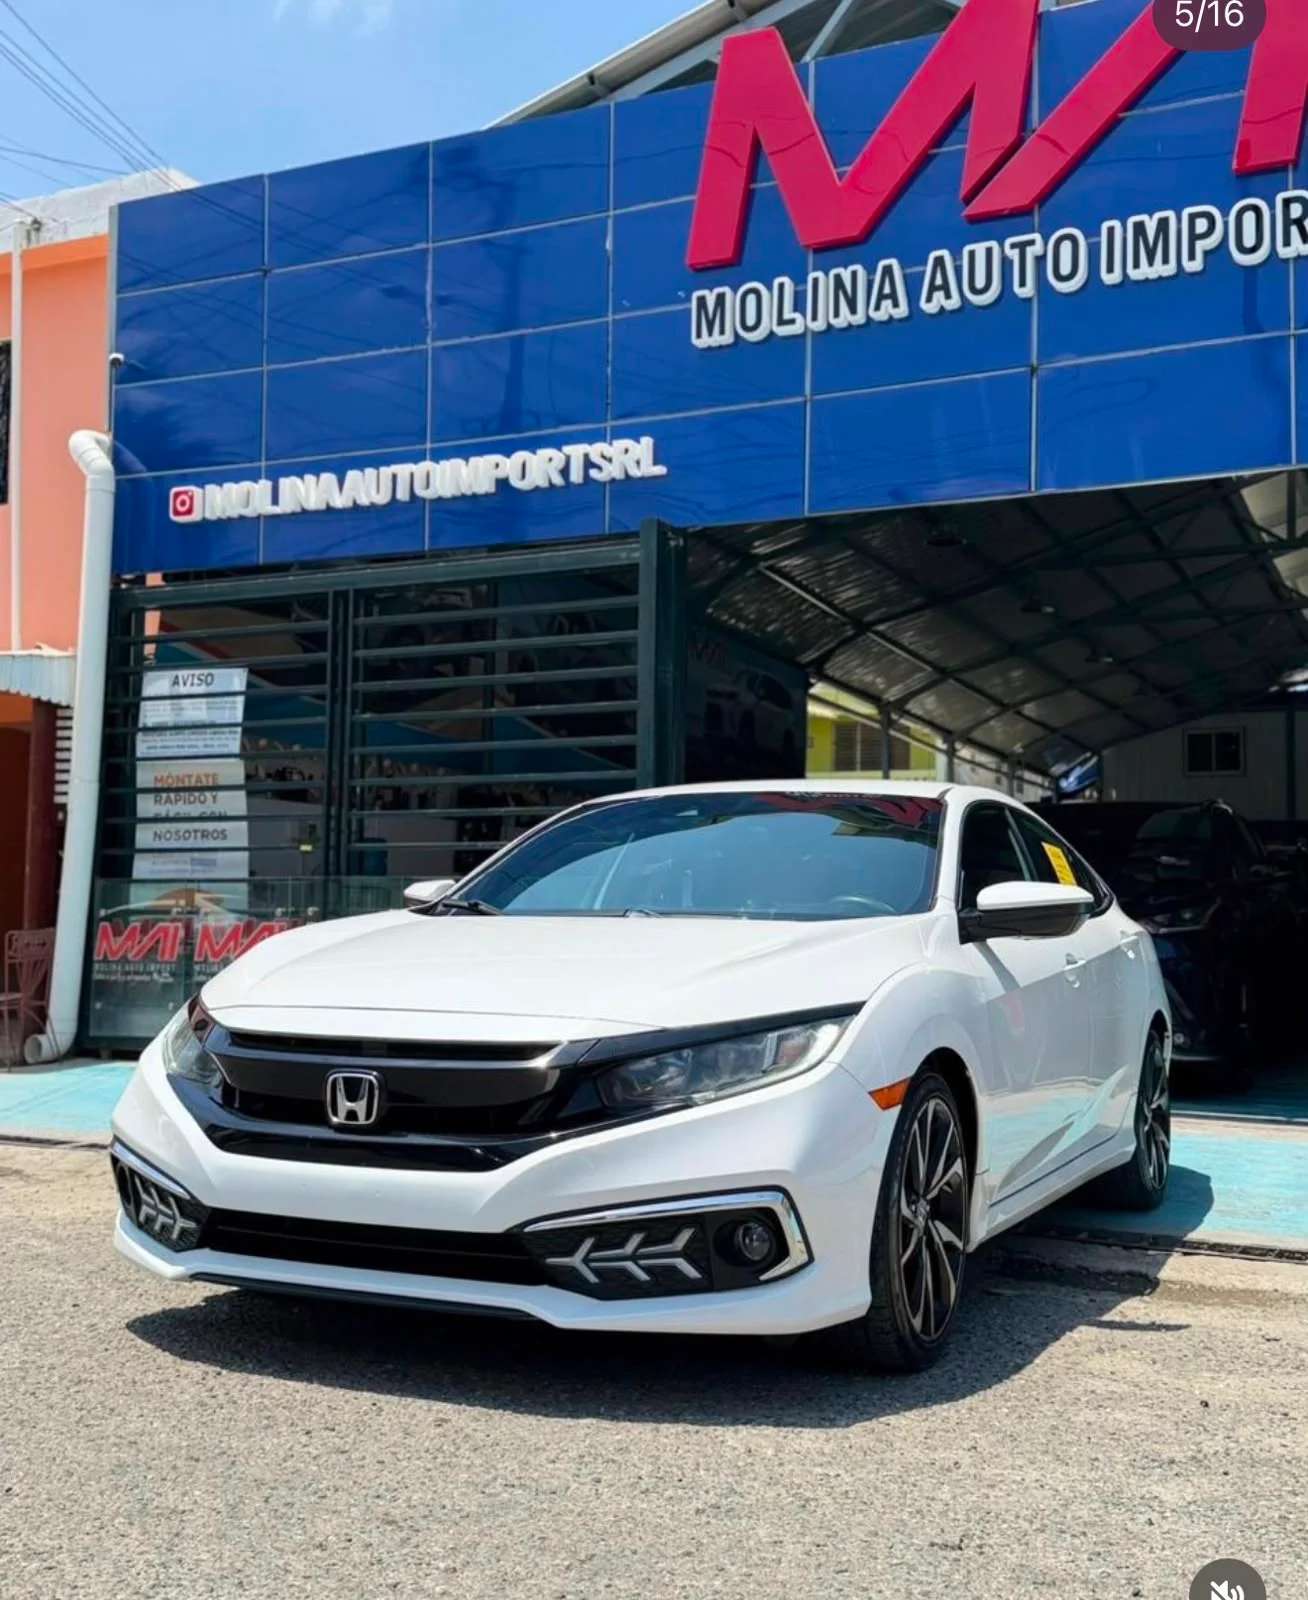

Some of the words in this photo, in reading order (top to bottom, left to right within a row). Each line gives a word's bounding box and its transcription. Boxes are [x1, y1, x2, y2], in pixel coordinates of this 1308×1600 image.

[691, 257, 908, 349] MOLINA
[919, 227, 1089, 314] AUTO
[1100, 190, 1308, 286] IMPOR
[204, 436, 668, 520] MOLINAAUTOIMPORTSRL
[172, 672, 215, 688] AVISO
[211, 792, 219, 804] Y
[153, 828, 228, 842] NOSOTROS
